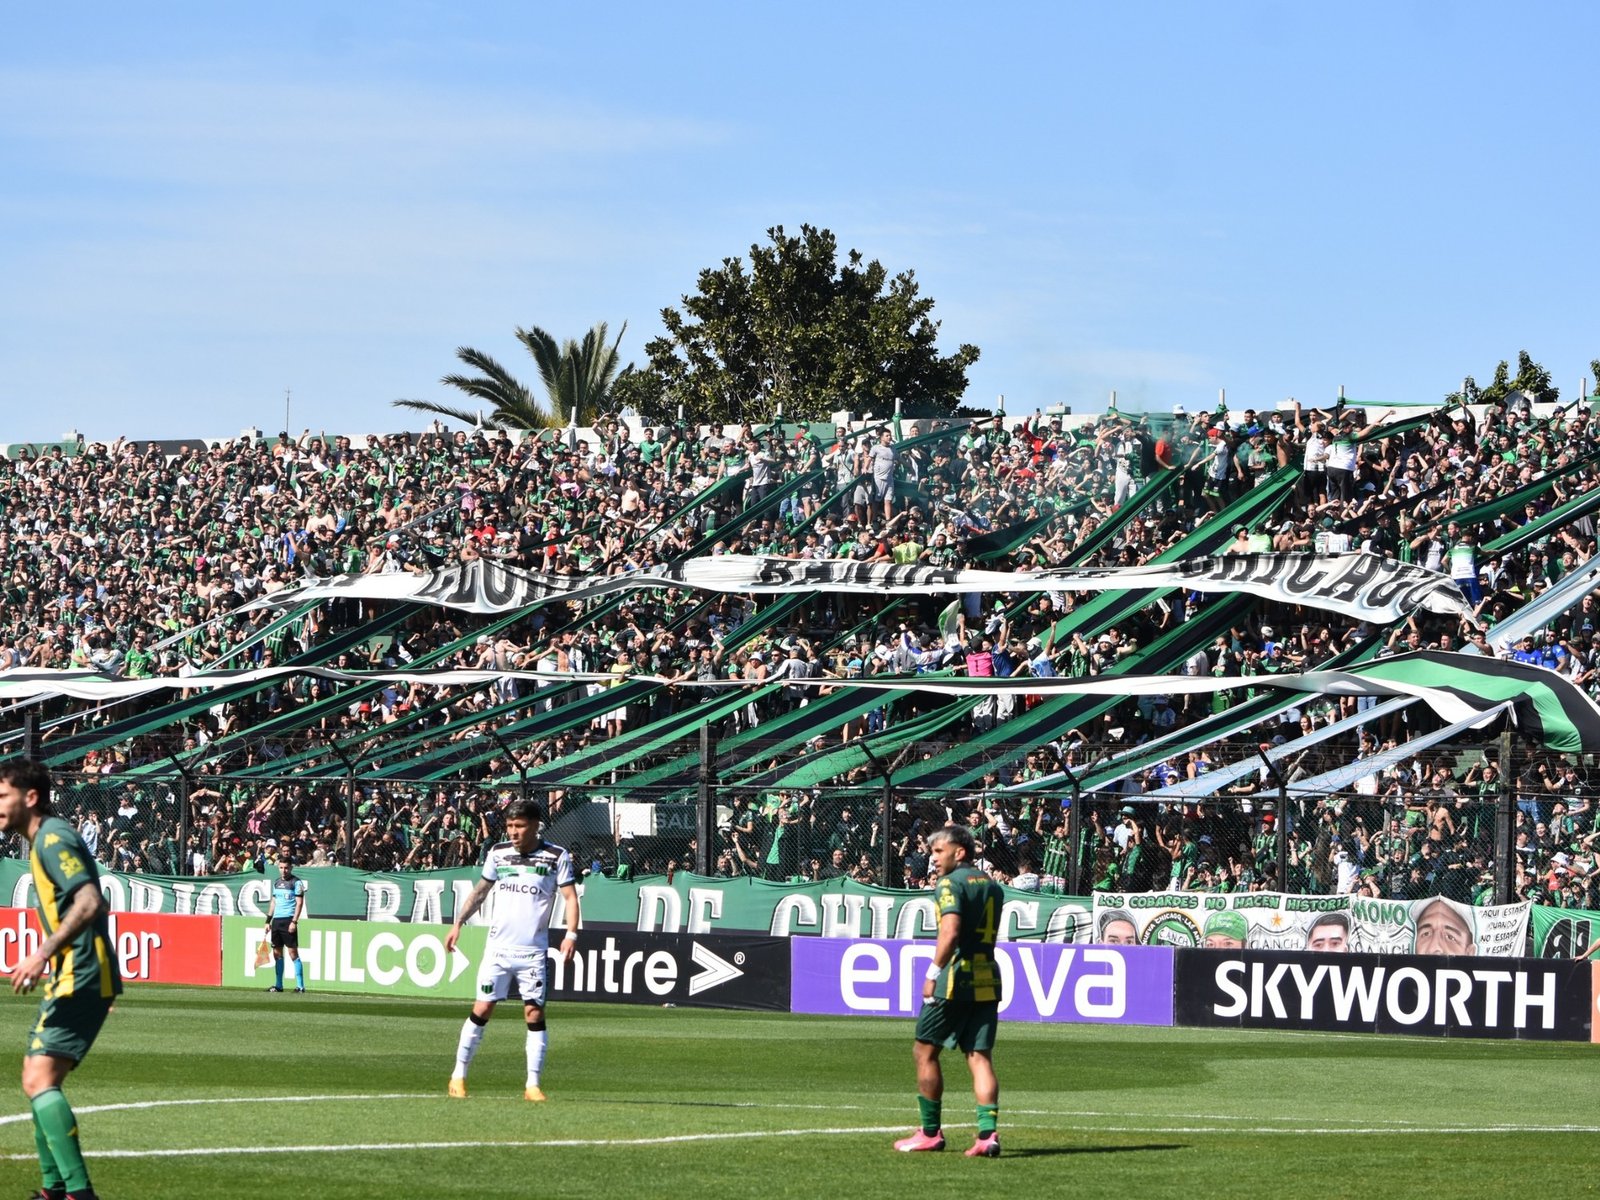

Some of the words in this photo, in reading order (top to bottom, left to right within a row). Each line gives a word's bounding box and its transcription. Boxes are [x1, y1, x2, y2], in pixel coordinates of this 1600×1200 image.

[500, 883, 538, 895] PHILCO
[1098, 895, 1125, 908] LOS
[1129, 894, 1199, 909] COBARDES
[1204, 897, 1227, 911] NO
[1233, 895, 1281, 909] HACEN
[364, 880, 586, 930] BANA
[636, 886, 724, 934] DE
[770, 893, 1092, 944] CHICGO
[976, 896, 997, 944] 4
[1353, 900, 1407, 926] MONO
[1481, 934, 1491, 942] NO
[547, 937, 678, 995] mitre
[1213, 960, 1557, 1030] SKYWORTH
